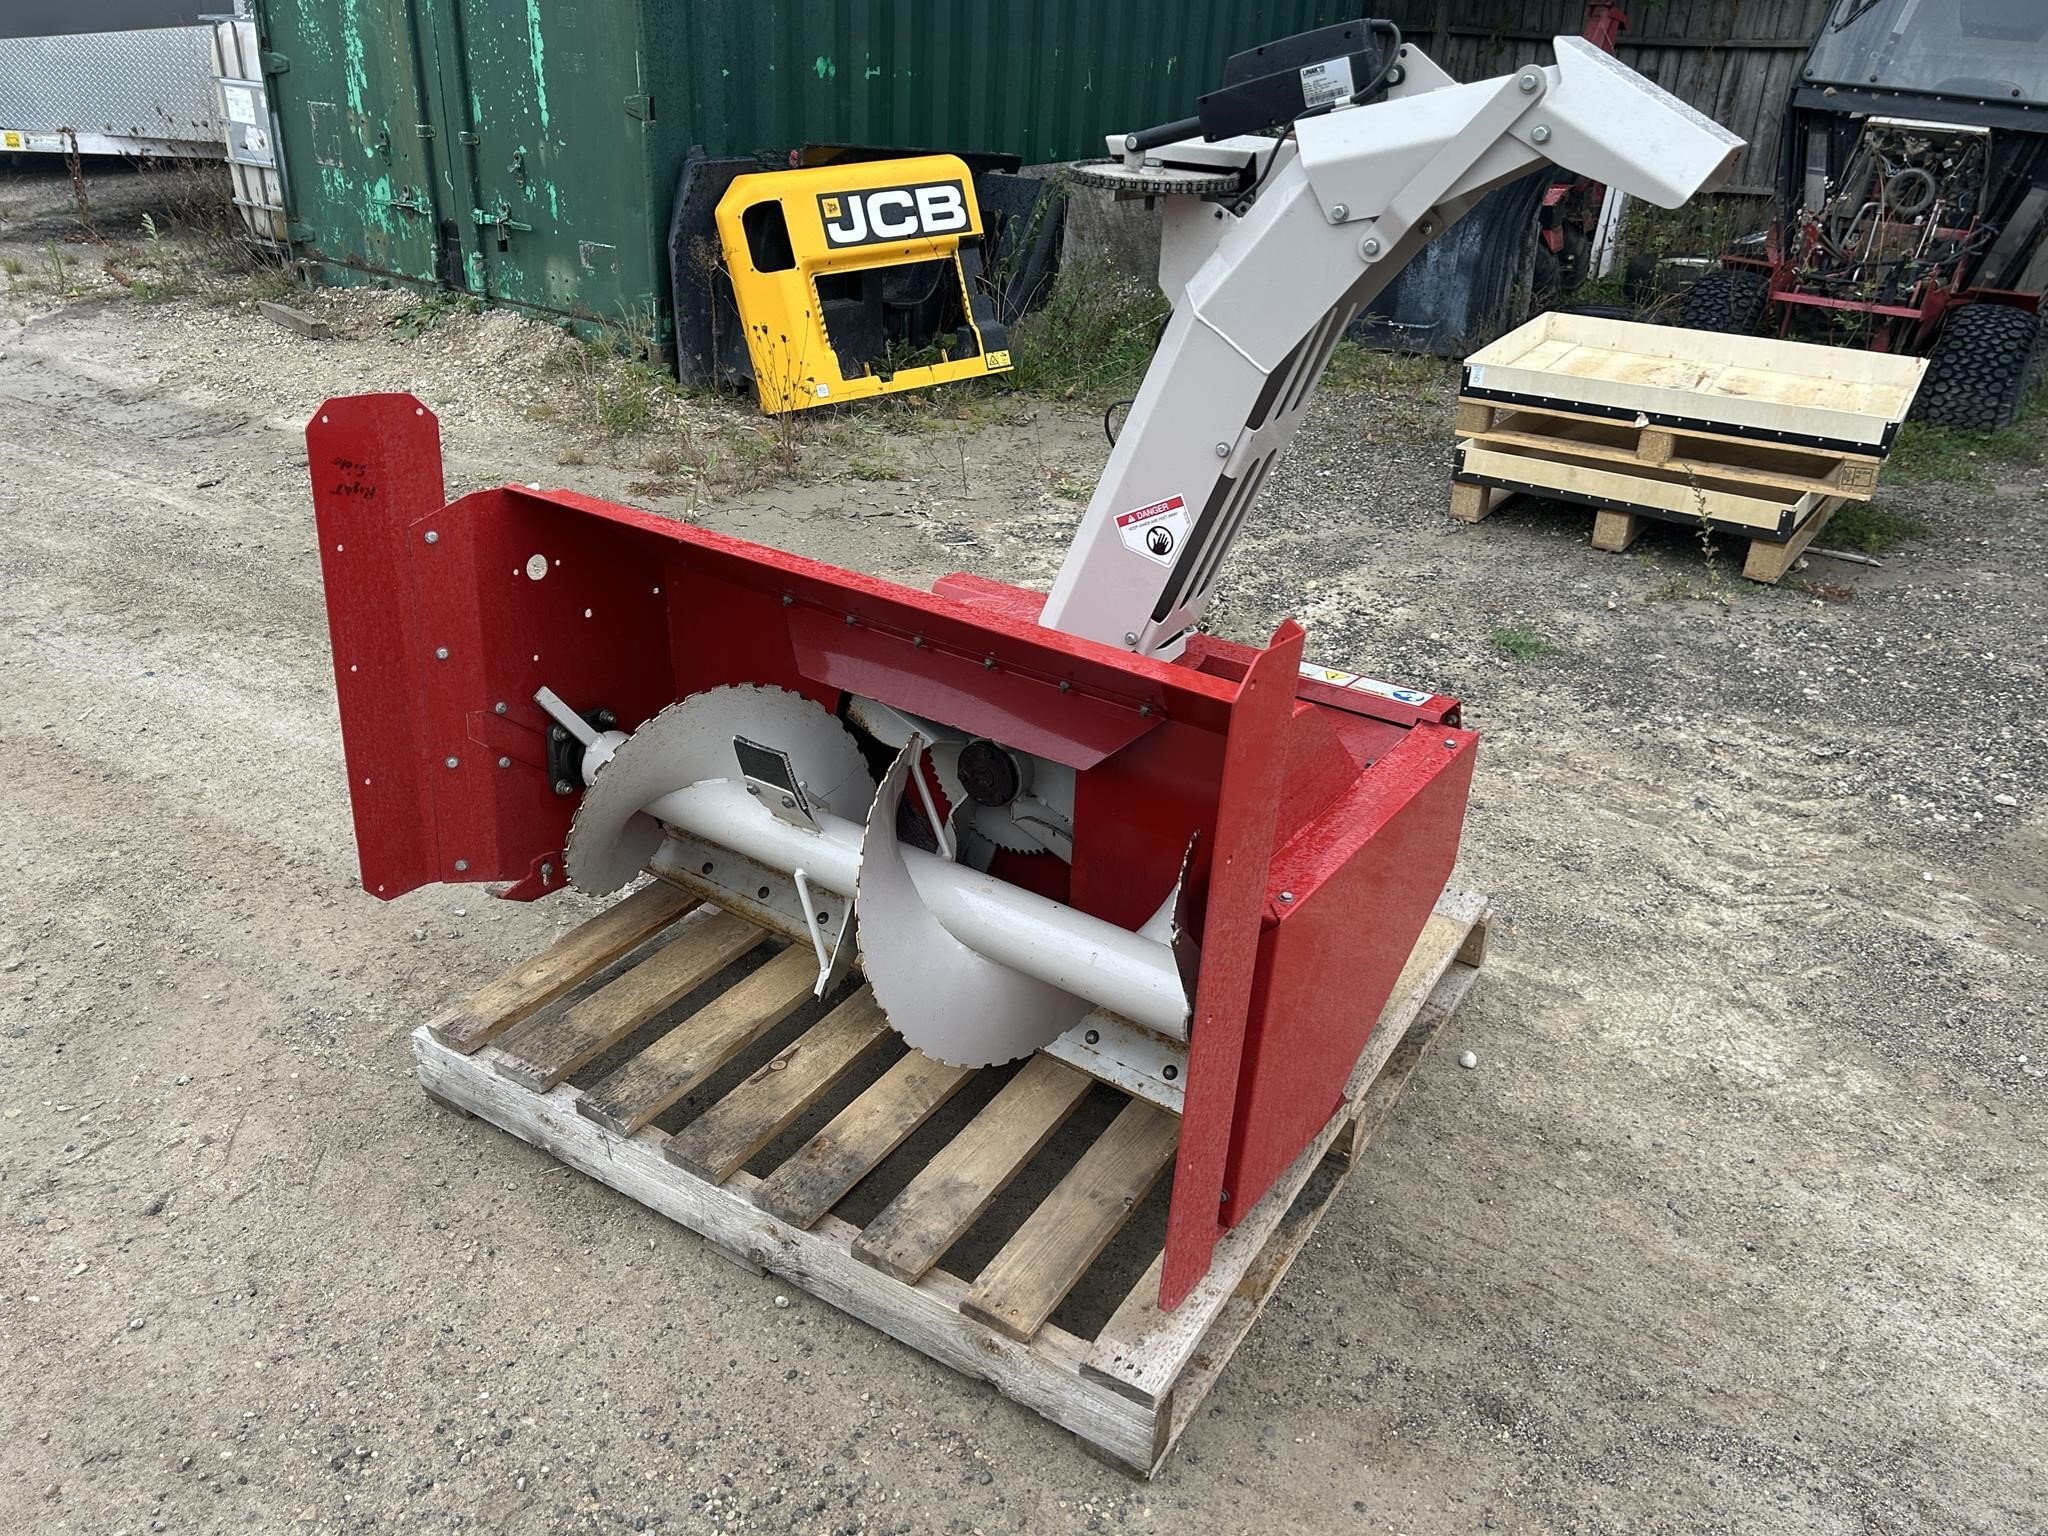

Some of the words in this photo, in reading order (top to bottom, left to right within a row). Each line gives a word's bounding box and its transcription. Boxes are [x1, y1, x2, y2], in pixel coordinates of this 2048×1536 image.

[826, 185, 967, 244] JCB
[1136, 502, 1169, 520] DANGER
[1138, 520, 1151, 528] HANDS
